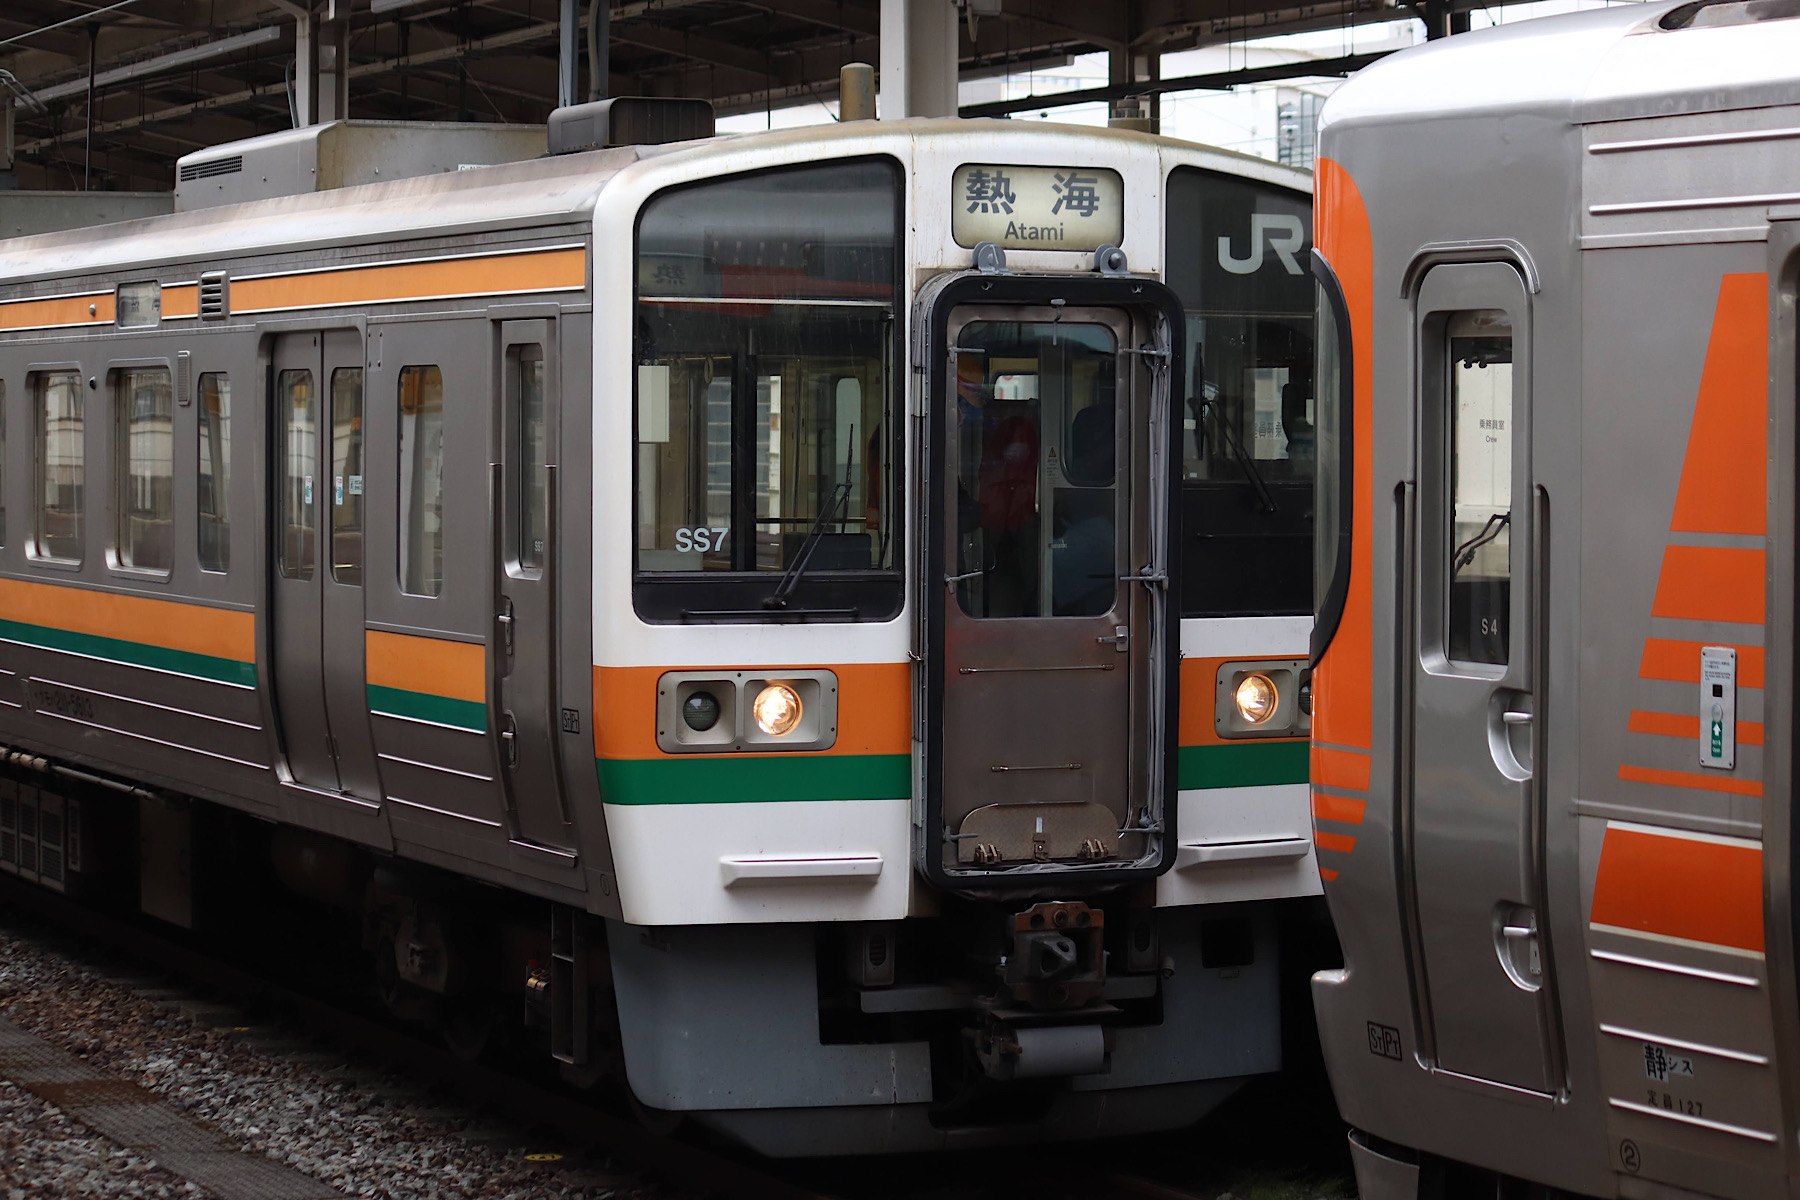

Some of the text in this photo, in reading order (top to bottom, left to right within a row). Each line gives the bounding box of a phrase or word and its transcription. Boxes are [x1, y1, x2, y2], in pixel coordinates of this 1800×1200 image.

[965, 168, 1101, 218] 熱海
[1004, 220, 1064, 241] Atami
[1217, 213, 1304, 275] JR
[1485, 434, 1498, 443] Crew
[534, 540, 544, 553] SS7
[675, 527, 729, 553] SS7
